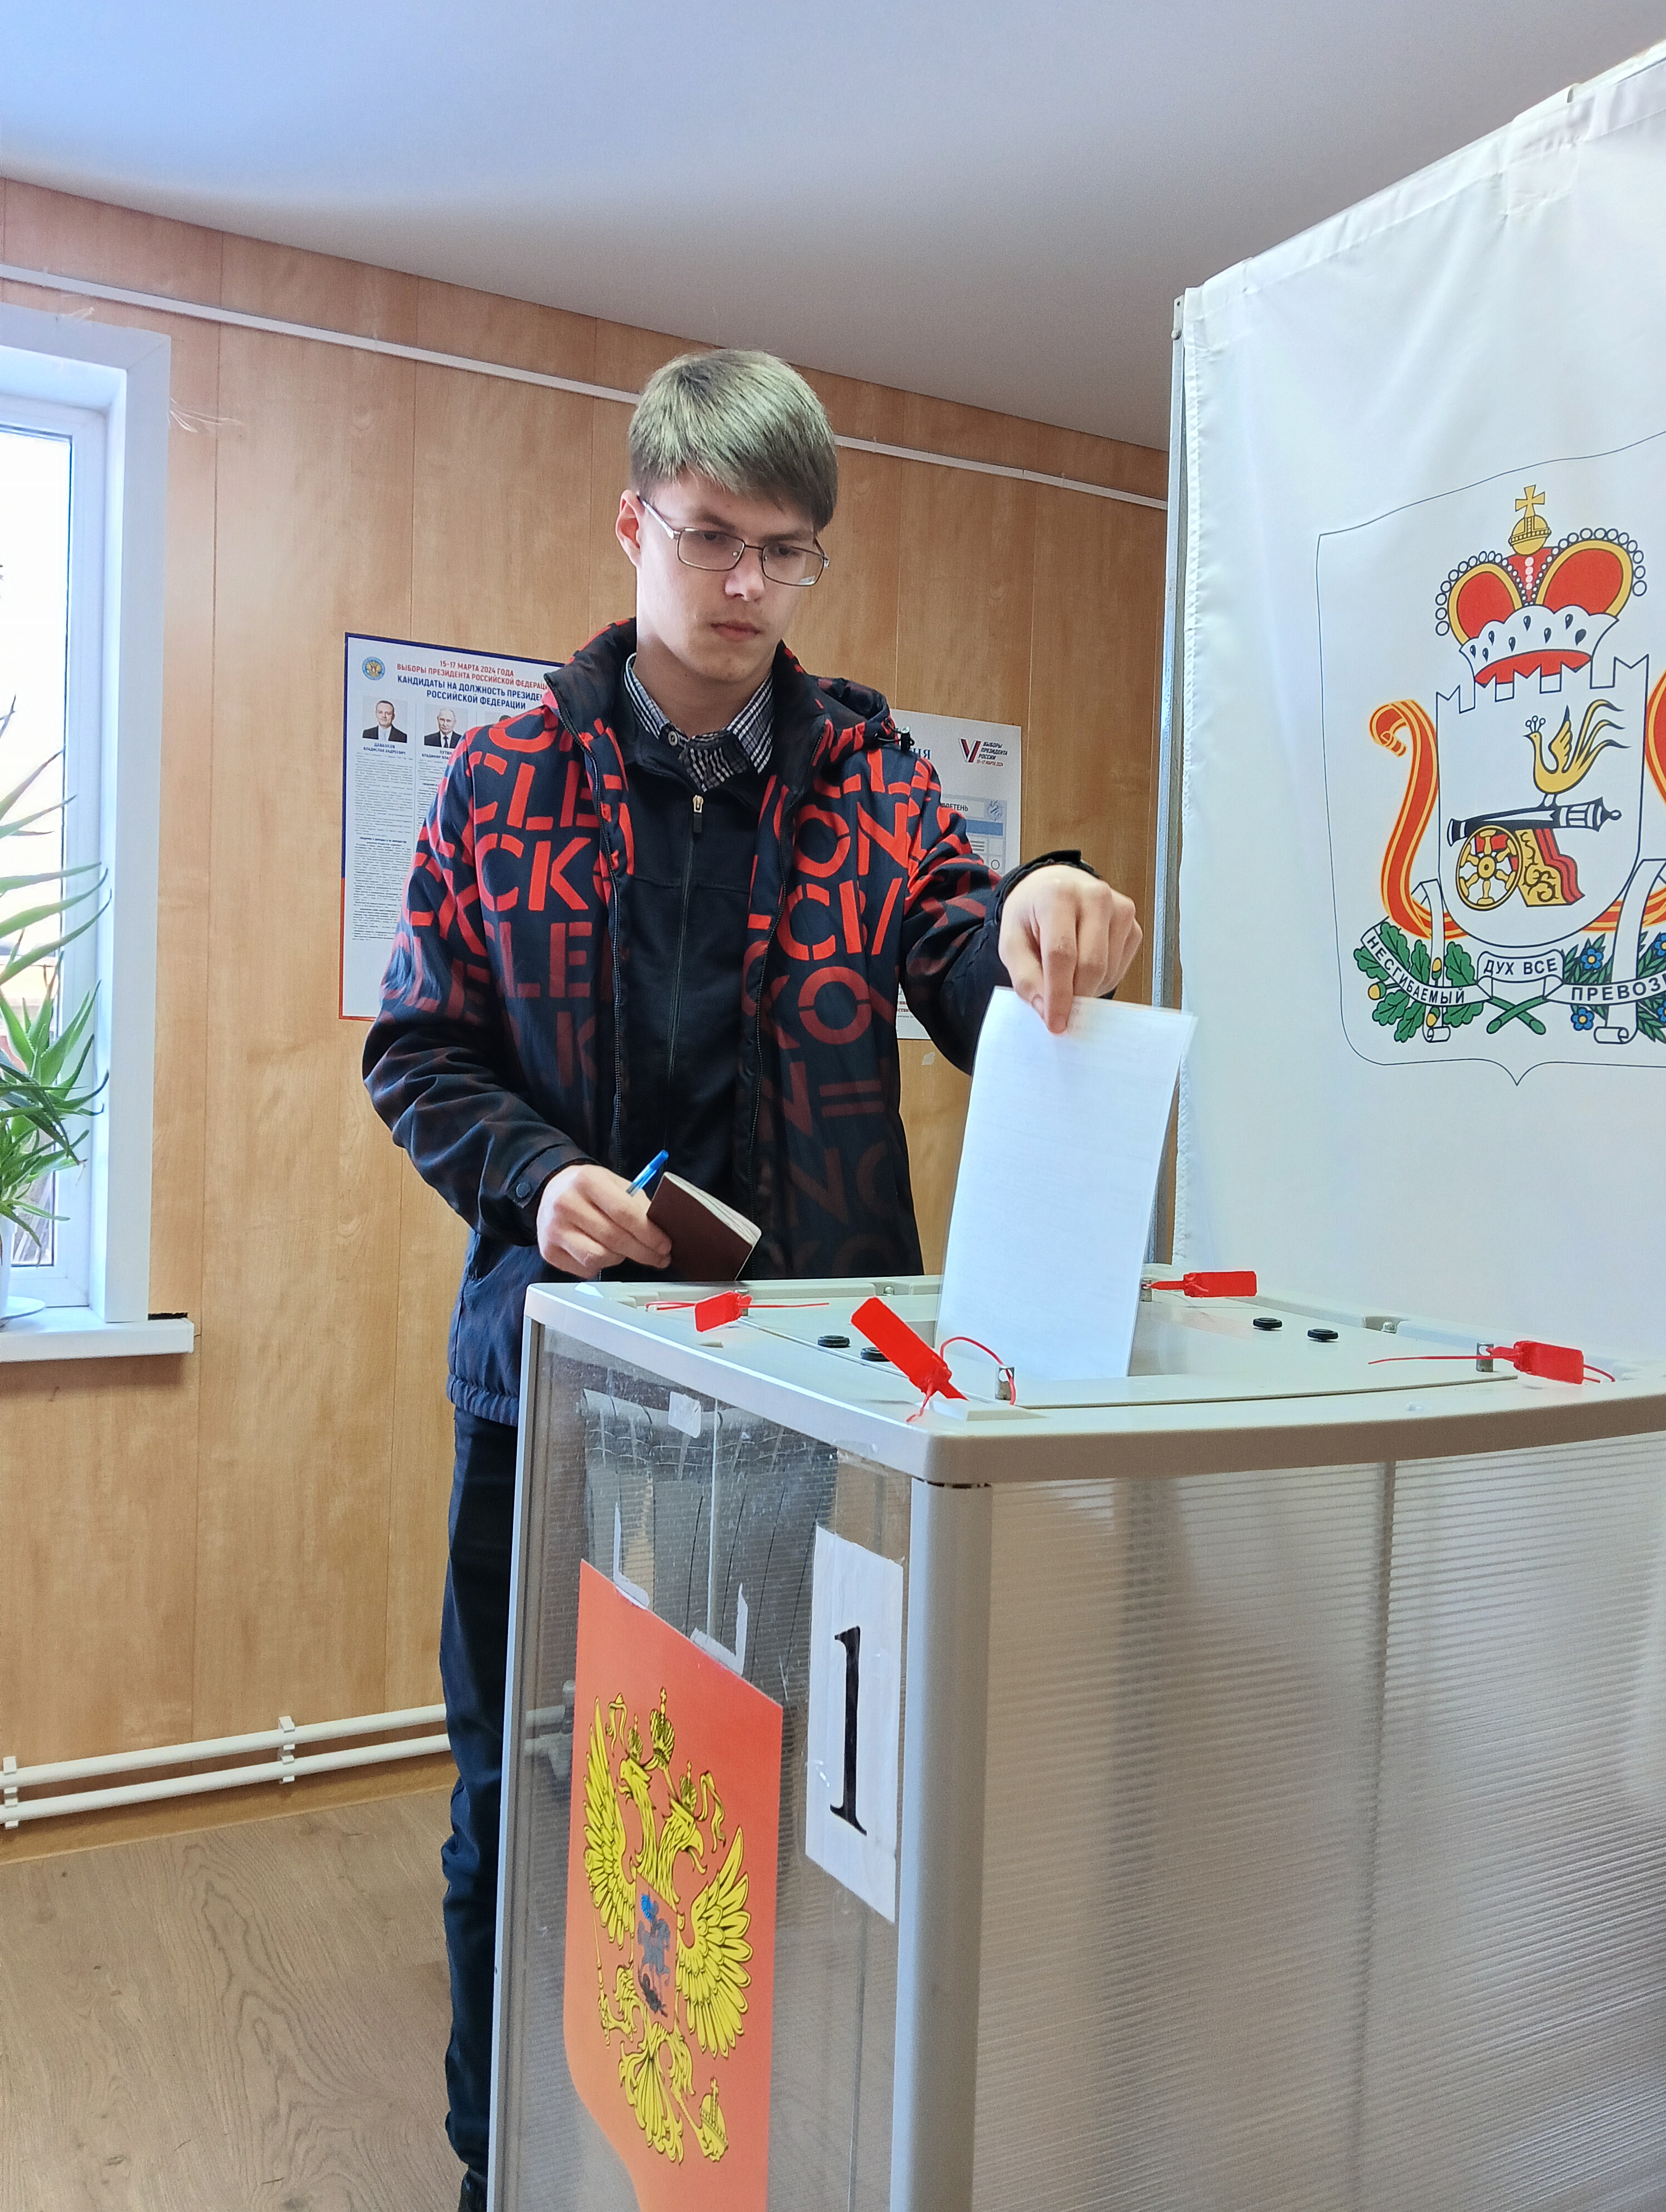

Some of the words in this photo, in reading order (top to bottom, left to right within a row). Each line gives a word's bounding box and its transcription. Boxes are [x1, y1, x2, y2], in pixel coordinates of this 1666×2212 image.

[397, 663, 426, 674] ВЫБОРЫ
[428, 667, 470, 679] ПРЕЗИДЕНТА
[472, 673, 514, 686] РОССИЙСКОЙ
[440, 660, 456, 668] 15-17
[457, 663, 479, 672] МАРТА
[480, 666, 496, 674] 2024
[497, 668, 514, 677] ГОДА
[398, 675, 445, 689] КАНДИДАТЫ
[447, 681, 457, 690] НА
[458, 683, 505, 696] ДОЛЖНОСТЬ
[426, 690, 478, 704] РОССИЙСКОЙ
[480, 697, 526, 710] ФЕДЕРАЦИИ
[1366, 936, 1465, 1005] НЕСГИБАЕМЫЙ
[1482, 958, 1515, 975] ДУХ
[1523, 957, 1558, 975] ВСЕ
[829, 1624, 868, 1837] 1
